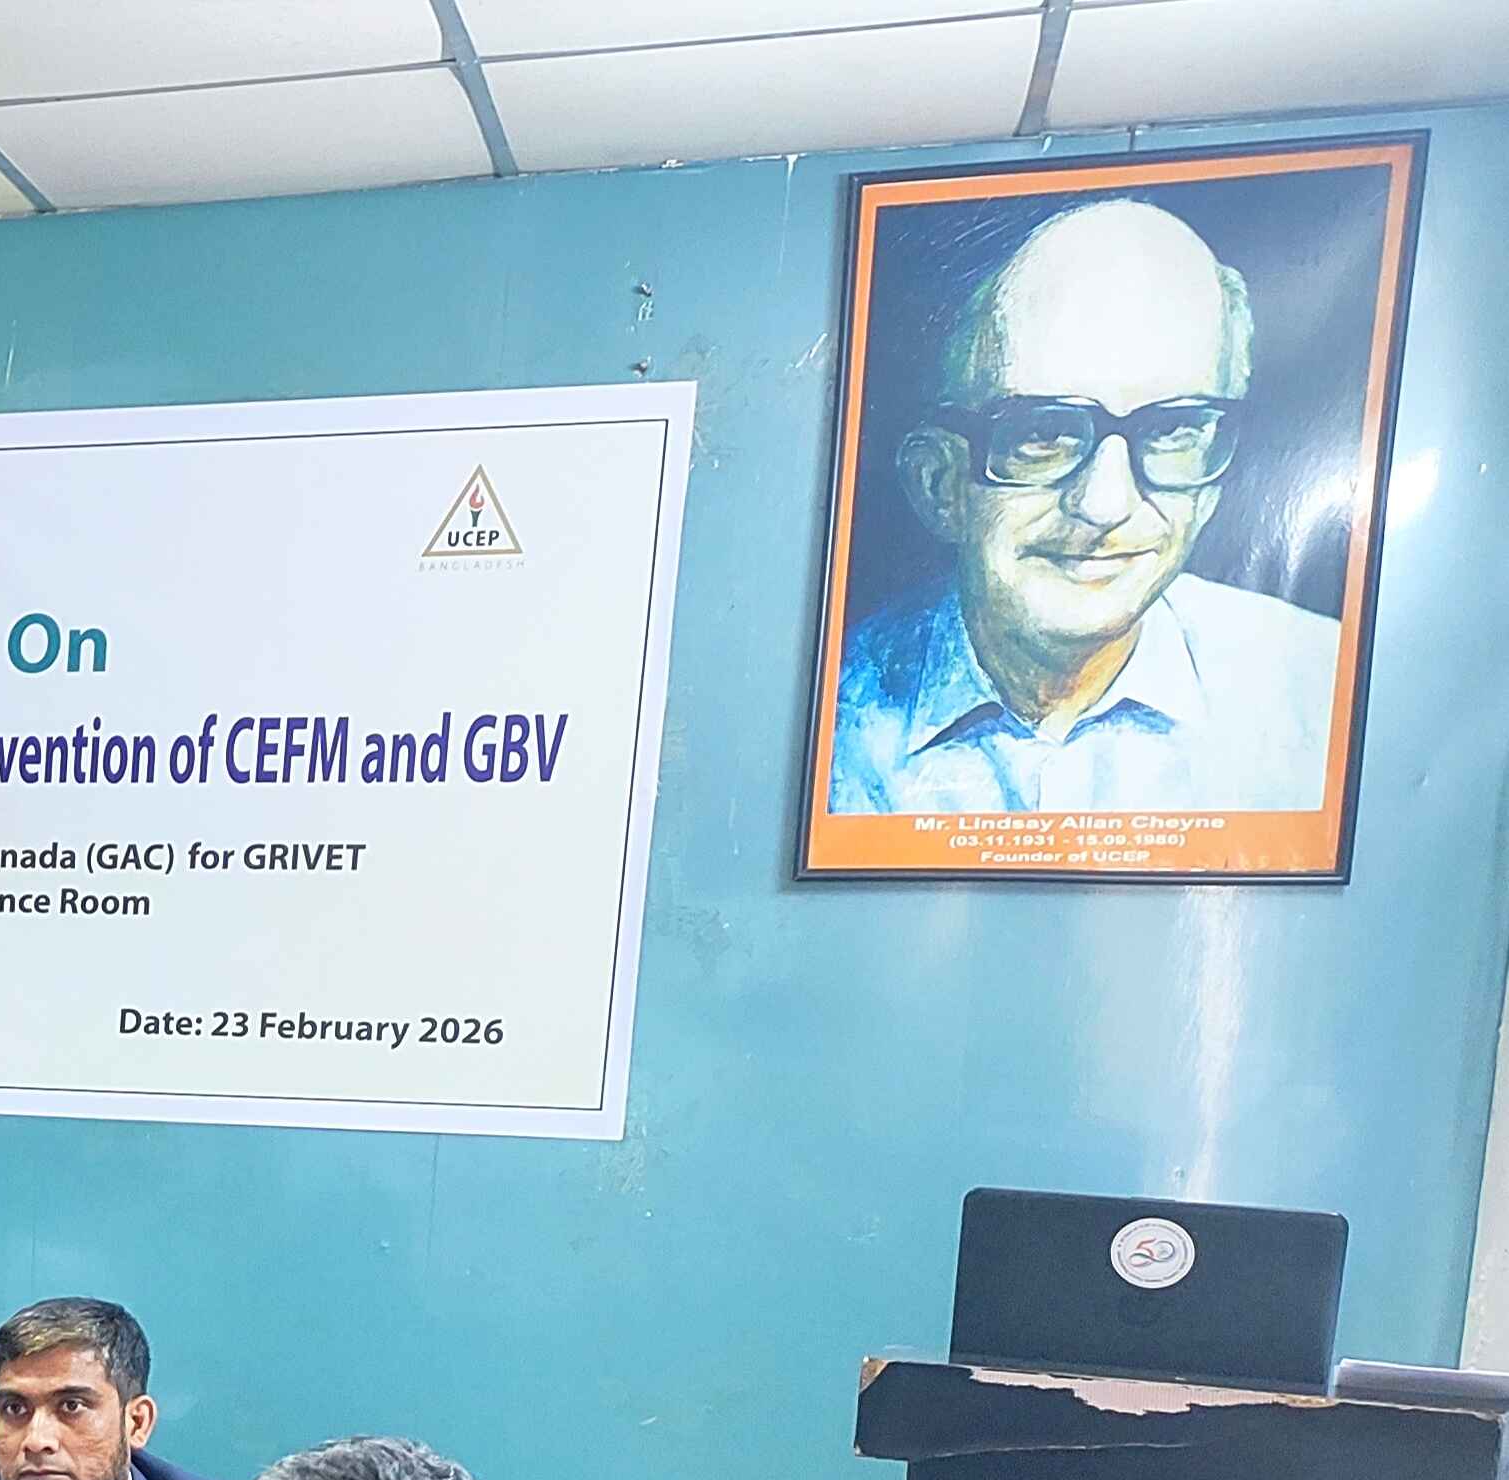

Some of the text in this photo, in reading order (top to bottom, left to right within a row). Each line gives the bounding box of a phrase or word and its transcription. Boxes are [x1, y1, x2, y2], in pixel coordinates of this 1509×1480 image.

[448, 530, 500, 547] UCEP
[8, 613, 109, 674] On
[169, 714, 218, 785] of
[226, 716, 348, 785] CEFM
[361, 712, 451, 785] and
[463, 714, 569, 783] GBV
[914, 816, 1226, 832] Mr. Lindsay Allan Cheyne
[86, 842, 175, 874] (GAC)
[187, 841, 235, 871] for
[243, 842, 366, 872] GRIVET
[980, 850, 1150, 864] Founder of UCEP
[60, 888, 151, 917] Room
[119, 1008, 505, 1049] Date: 23 February 2026
